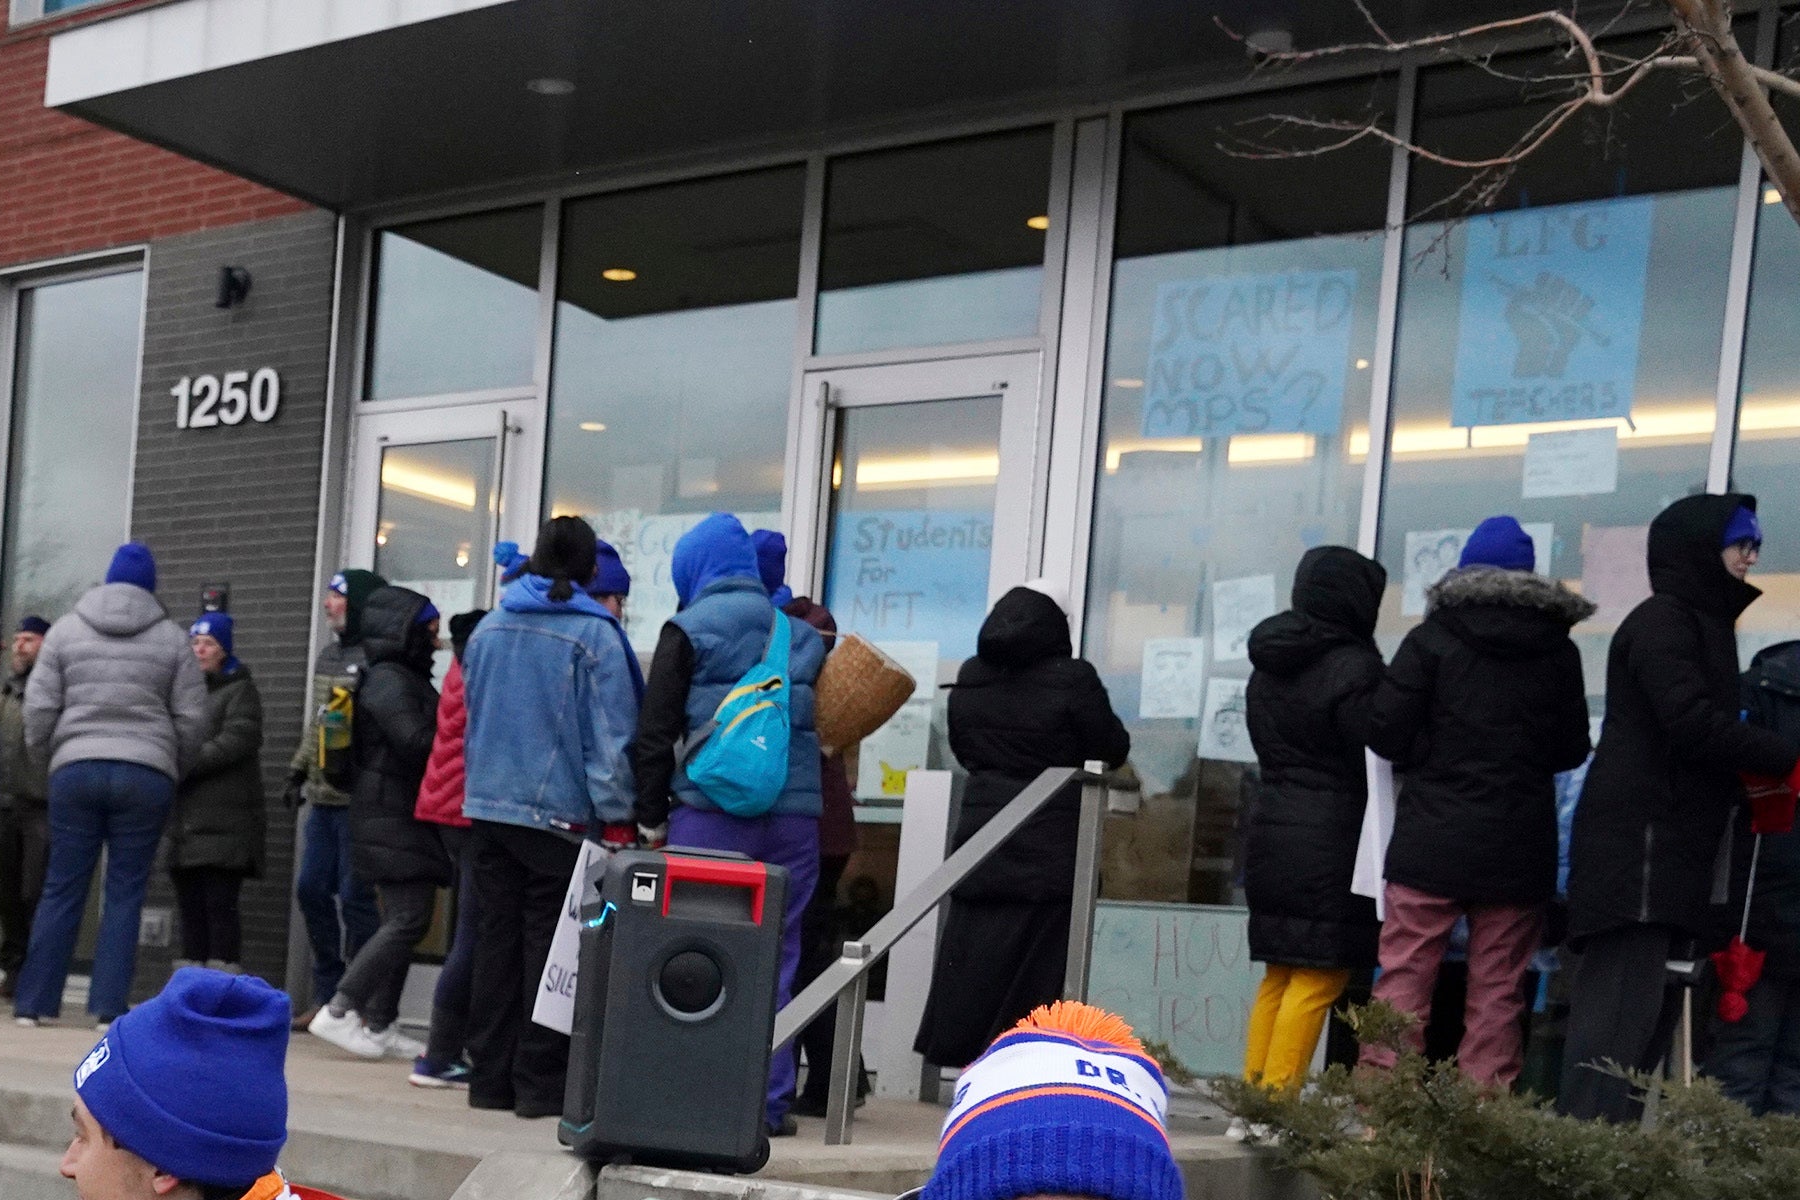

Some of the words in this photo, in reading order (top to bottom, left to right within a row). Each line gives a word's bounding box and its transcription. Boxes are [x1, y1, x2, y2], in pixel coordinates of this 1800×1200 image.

[1153, 276, 1351, 352] SCARED
[170, 366, 280, 430] 1250
[1150, 343, 1301, 398] NOW
